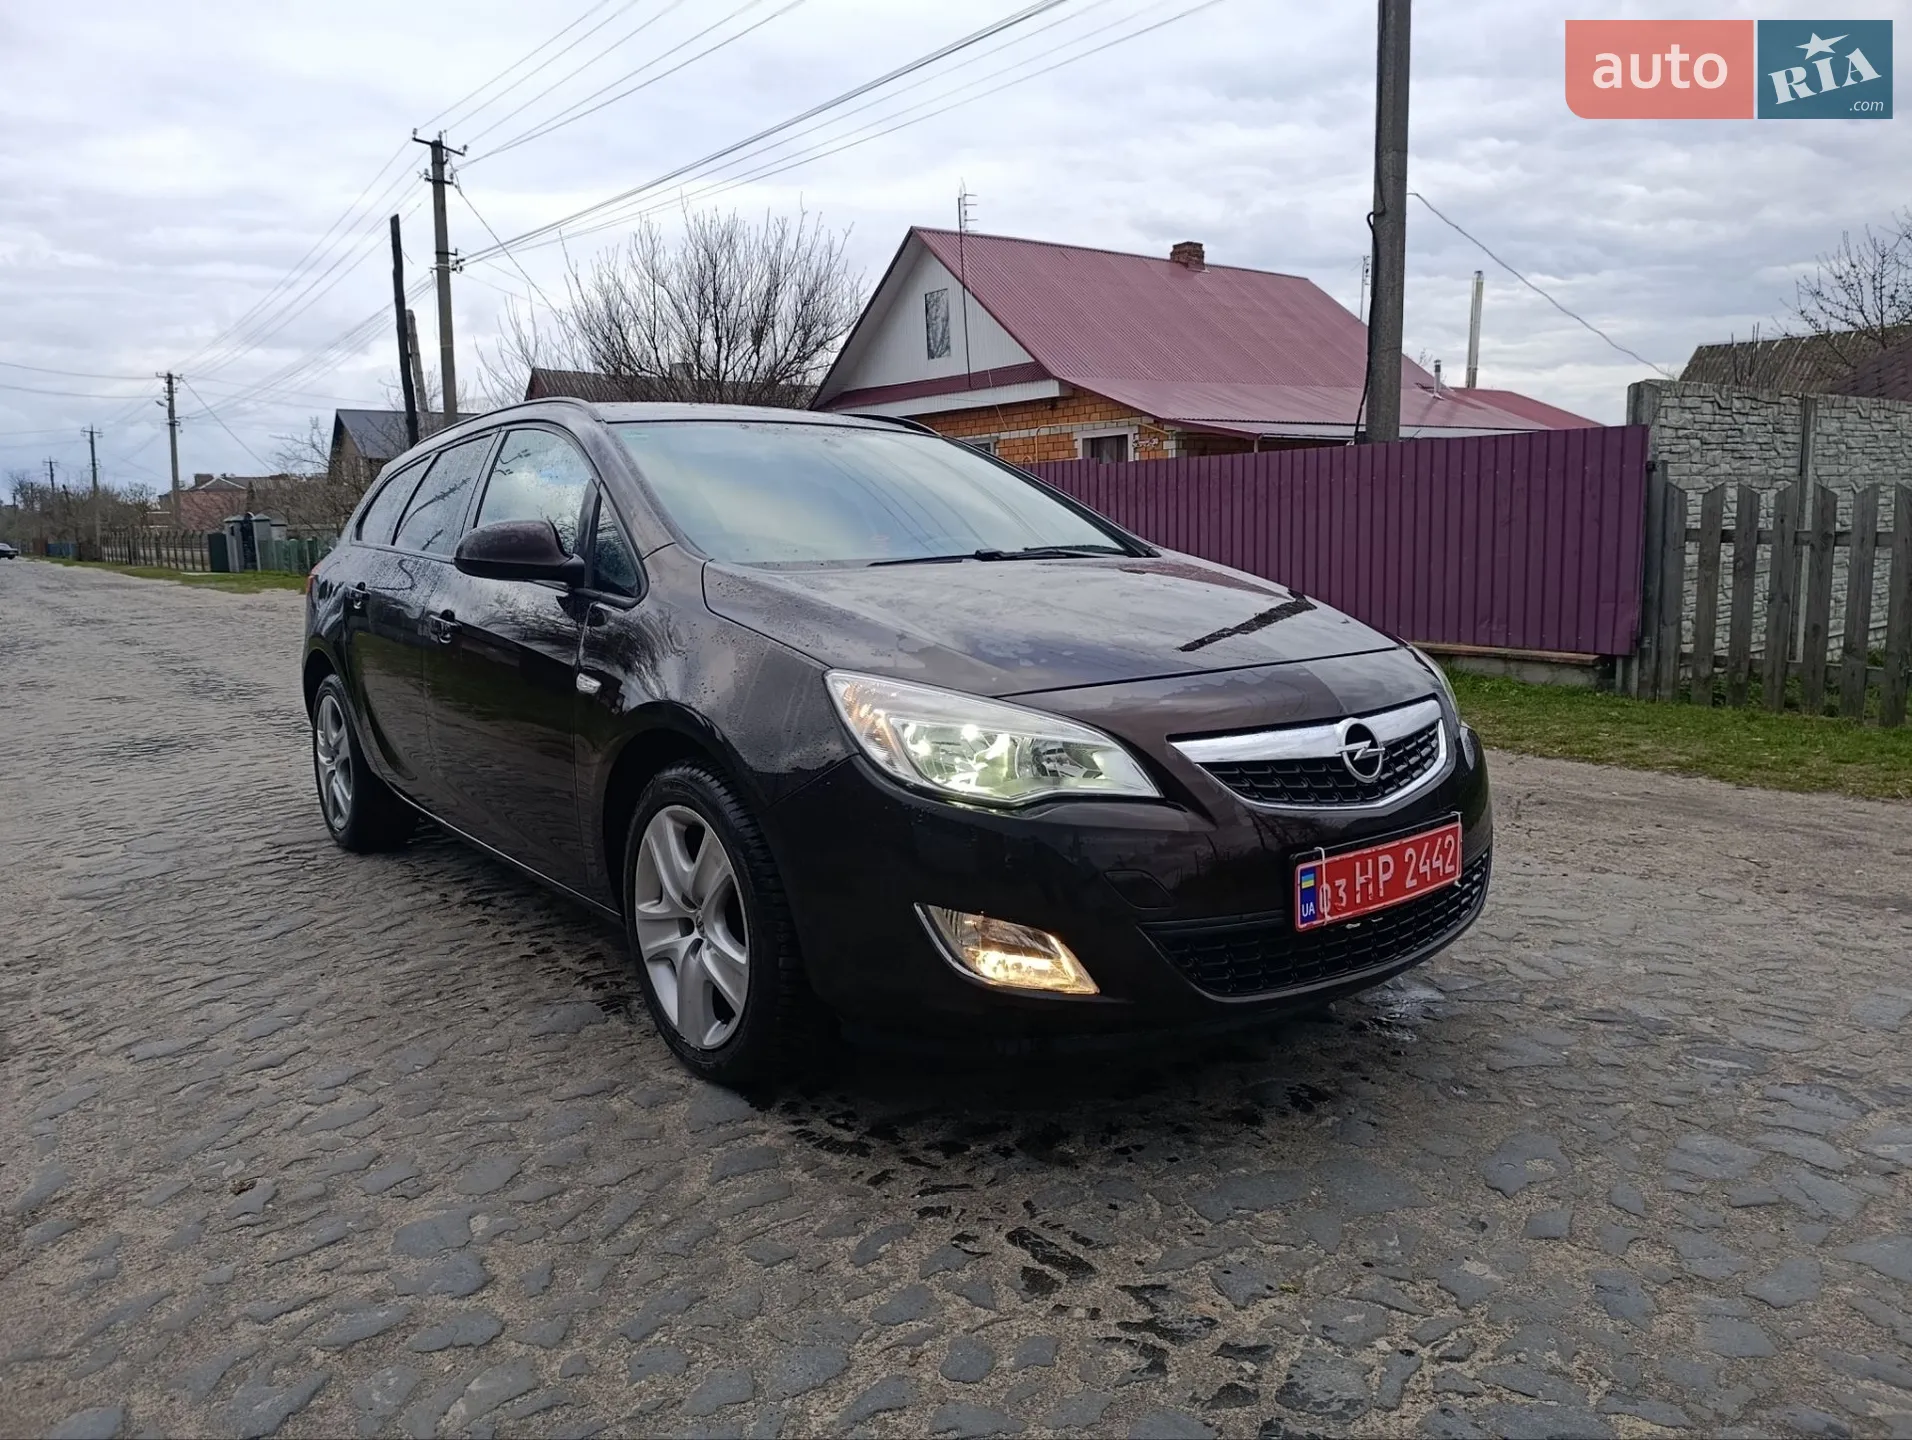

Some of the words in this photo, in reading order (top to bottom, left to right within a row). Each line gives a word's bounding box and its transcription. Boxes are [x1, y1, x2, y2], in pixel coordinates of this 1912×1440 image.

[1355, 854, 1395, 904] HP
[1404, 834, 1455, 889] 2442
[1302, 901, 1316, 917] UA
